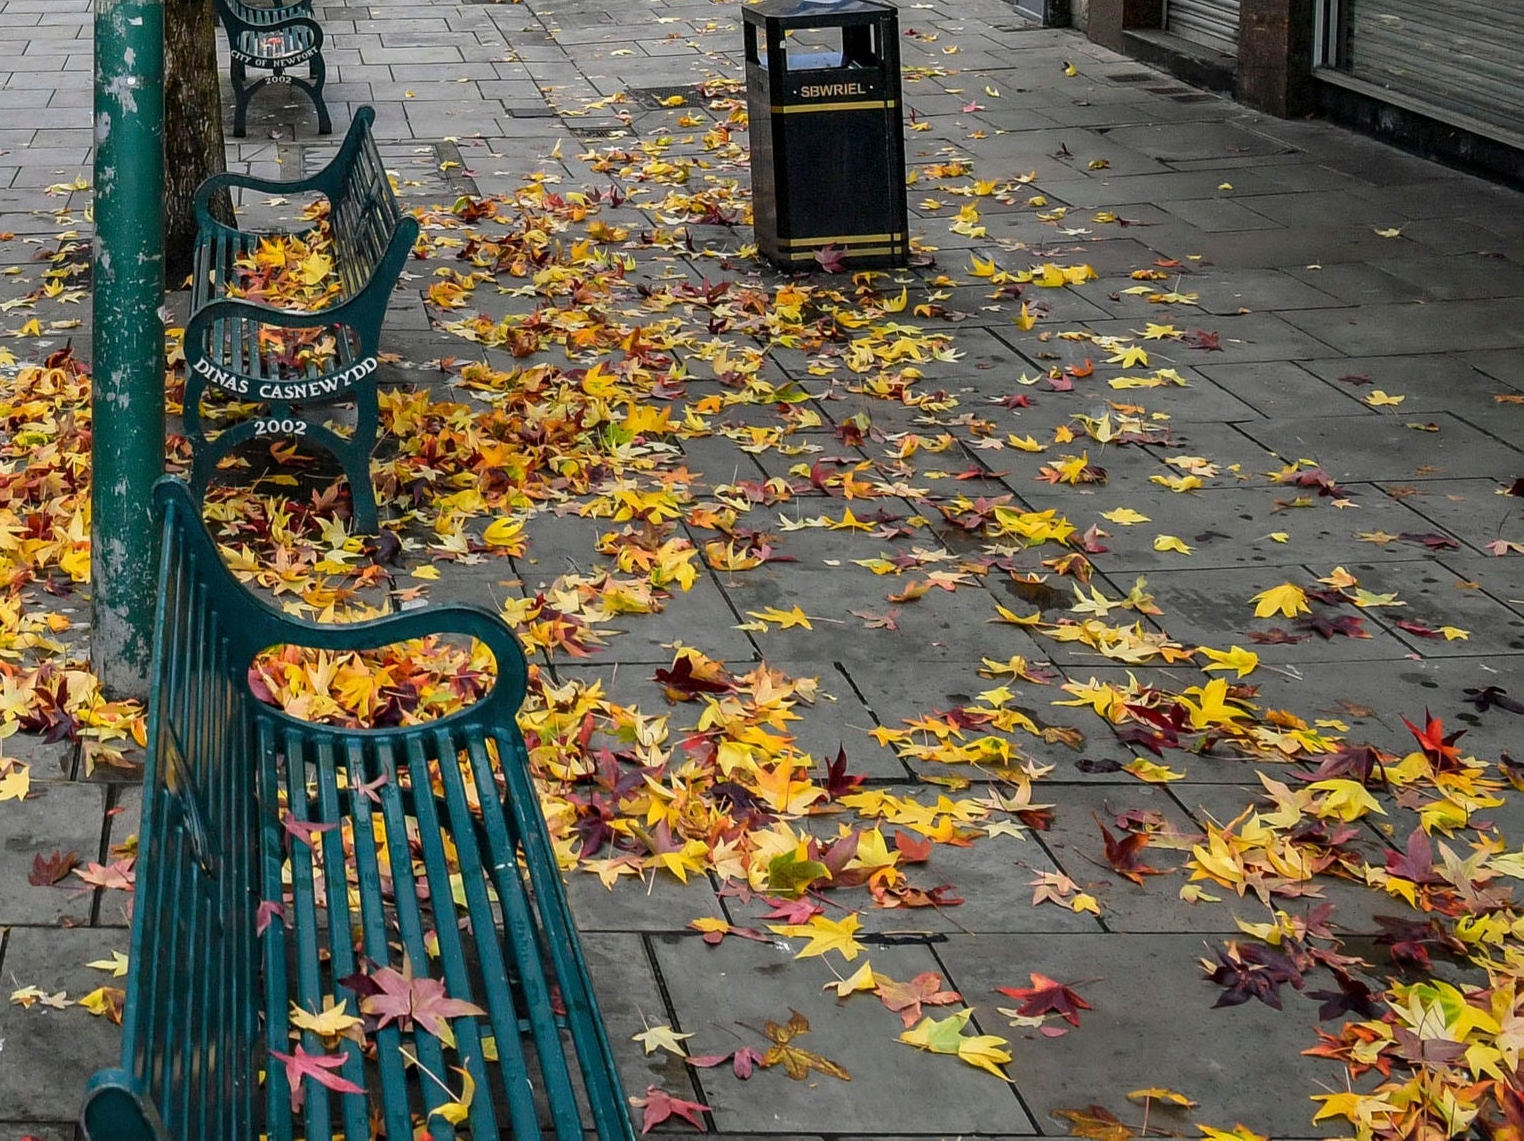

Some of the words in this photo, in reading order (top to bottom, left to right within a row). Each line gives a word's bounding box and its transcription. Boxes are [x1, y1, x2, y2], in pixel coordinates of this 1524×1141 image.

[231, 50, 251, 63] CITY
[273, 47, 318, 67] NEWPORT
[265, 77, 291, 85] 2002
[800, 83, 866, 98] SBWRIEL
[193, 358, 248, 394] DINAS
[260, 357, 378, 399] CASNEWYDD
[254, 419, 307, 436] 2002
